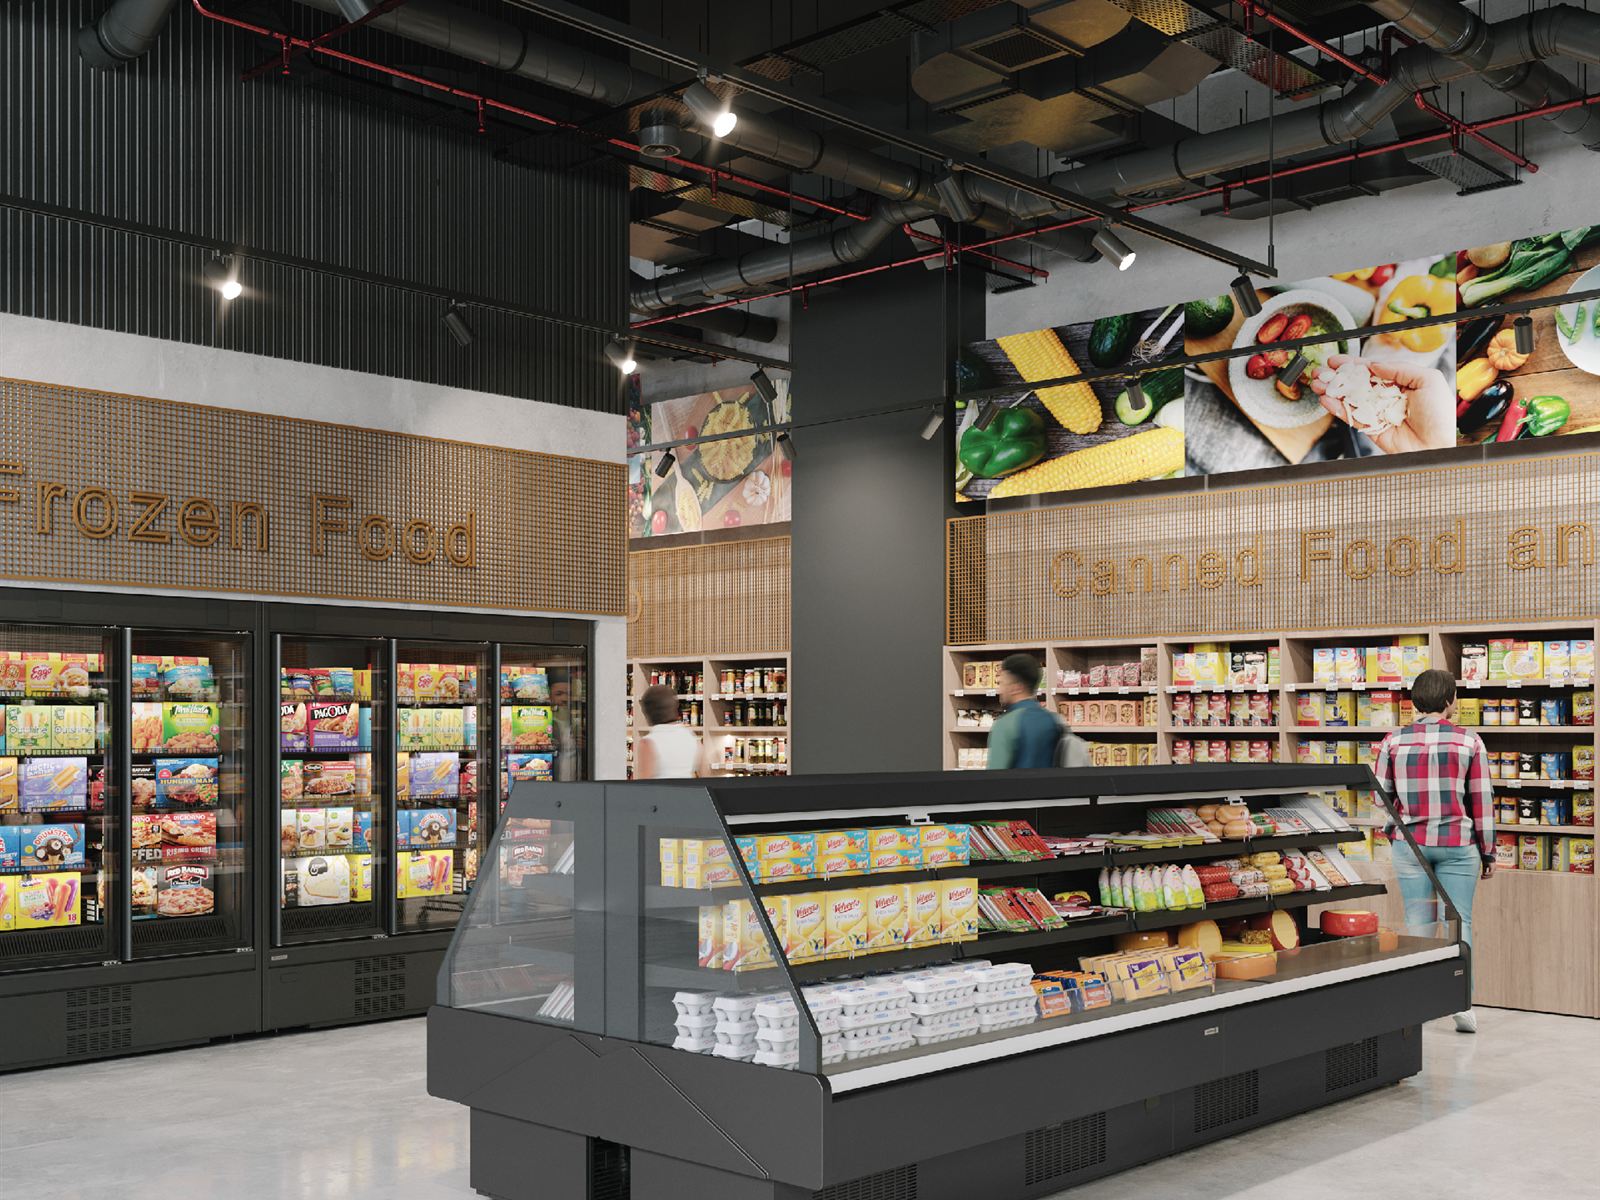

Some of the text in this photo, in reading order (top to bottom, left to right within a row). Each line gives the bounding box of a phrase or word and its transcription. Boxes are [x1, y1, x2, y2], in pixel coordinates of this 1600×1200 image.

[312, 493, 477, 569] Food
[1050, 534, 1264, 598] Canned
[1300, 518, 1466, 583] Food
[30, 665, 52, 681] Eggo
[313, 705, 348, 719] PAGODA
[160, 777, 214, 785] HUNGRY-MAN
[33, 828, 73, 846] DRUMSTICK
[166, 847, 189, 857] RISING
[167, 866, 205, 877] RED BARON
[67, 913, 77, 922] 18
